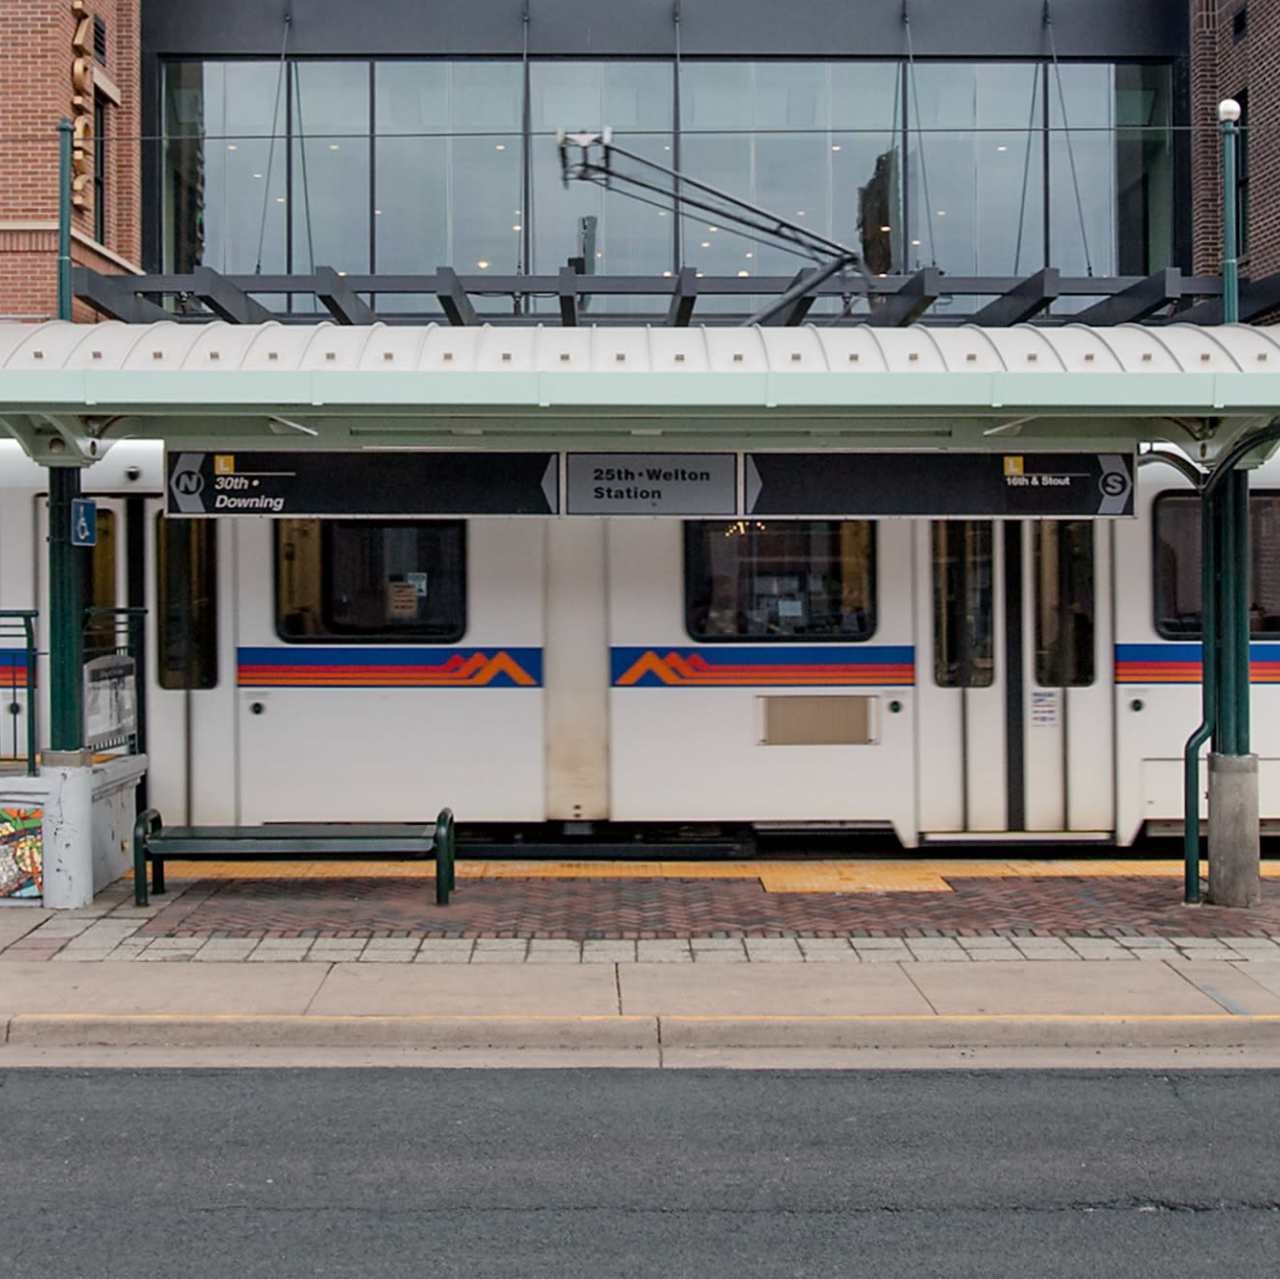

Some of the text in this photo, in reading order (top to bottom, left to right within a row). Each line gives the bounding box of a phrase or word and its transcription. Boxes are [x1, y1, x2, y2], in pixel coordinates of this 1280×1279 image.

[178, 474, 198, 492] N
[214, 476, 249, 490] 30th
[1041, 476, 1071, 486] Stout
[1104, 474, 1124, 494] S
[593, 486, 662, 500] Station
[215, 495, 285, 511] Downing
